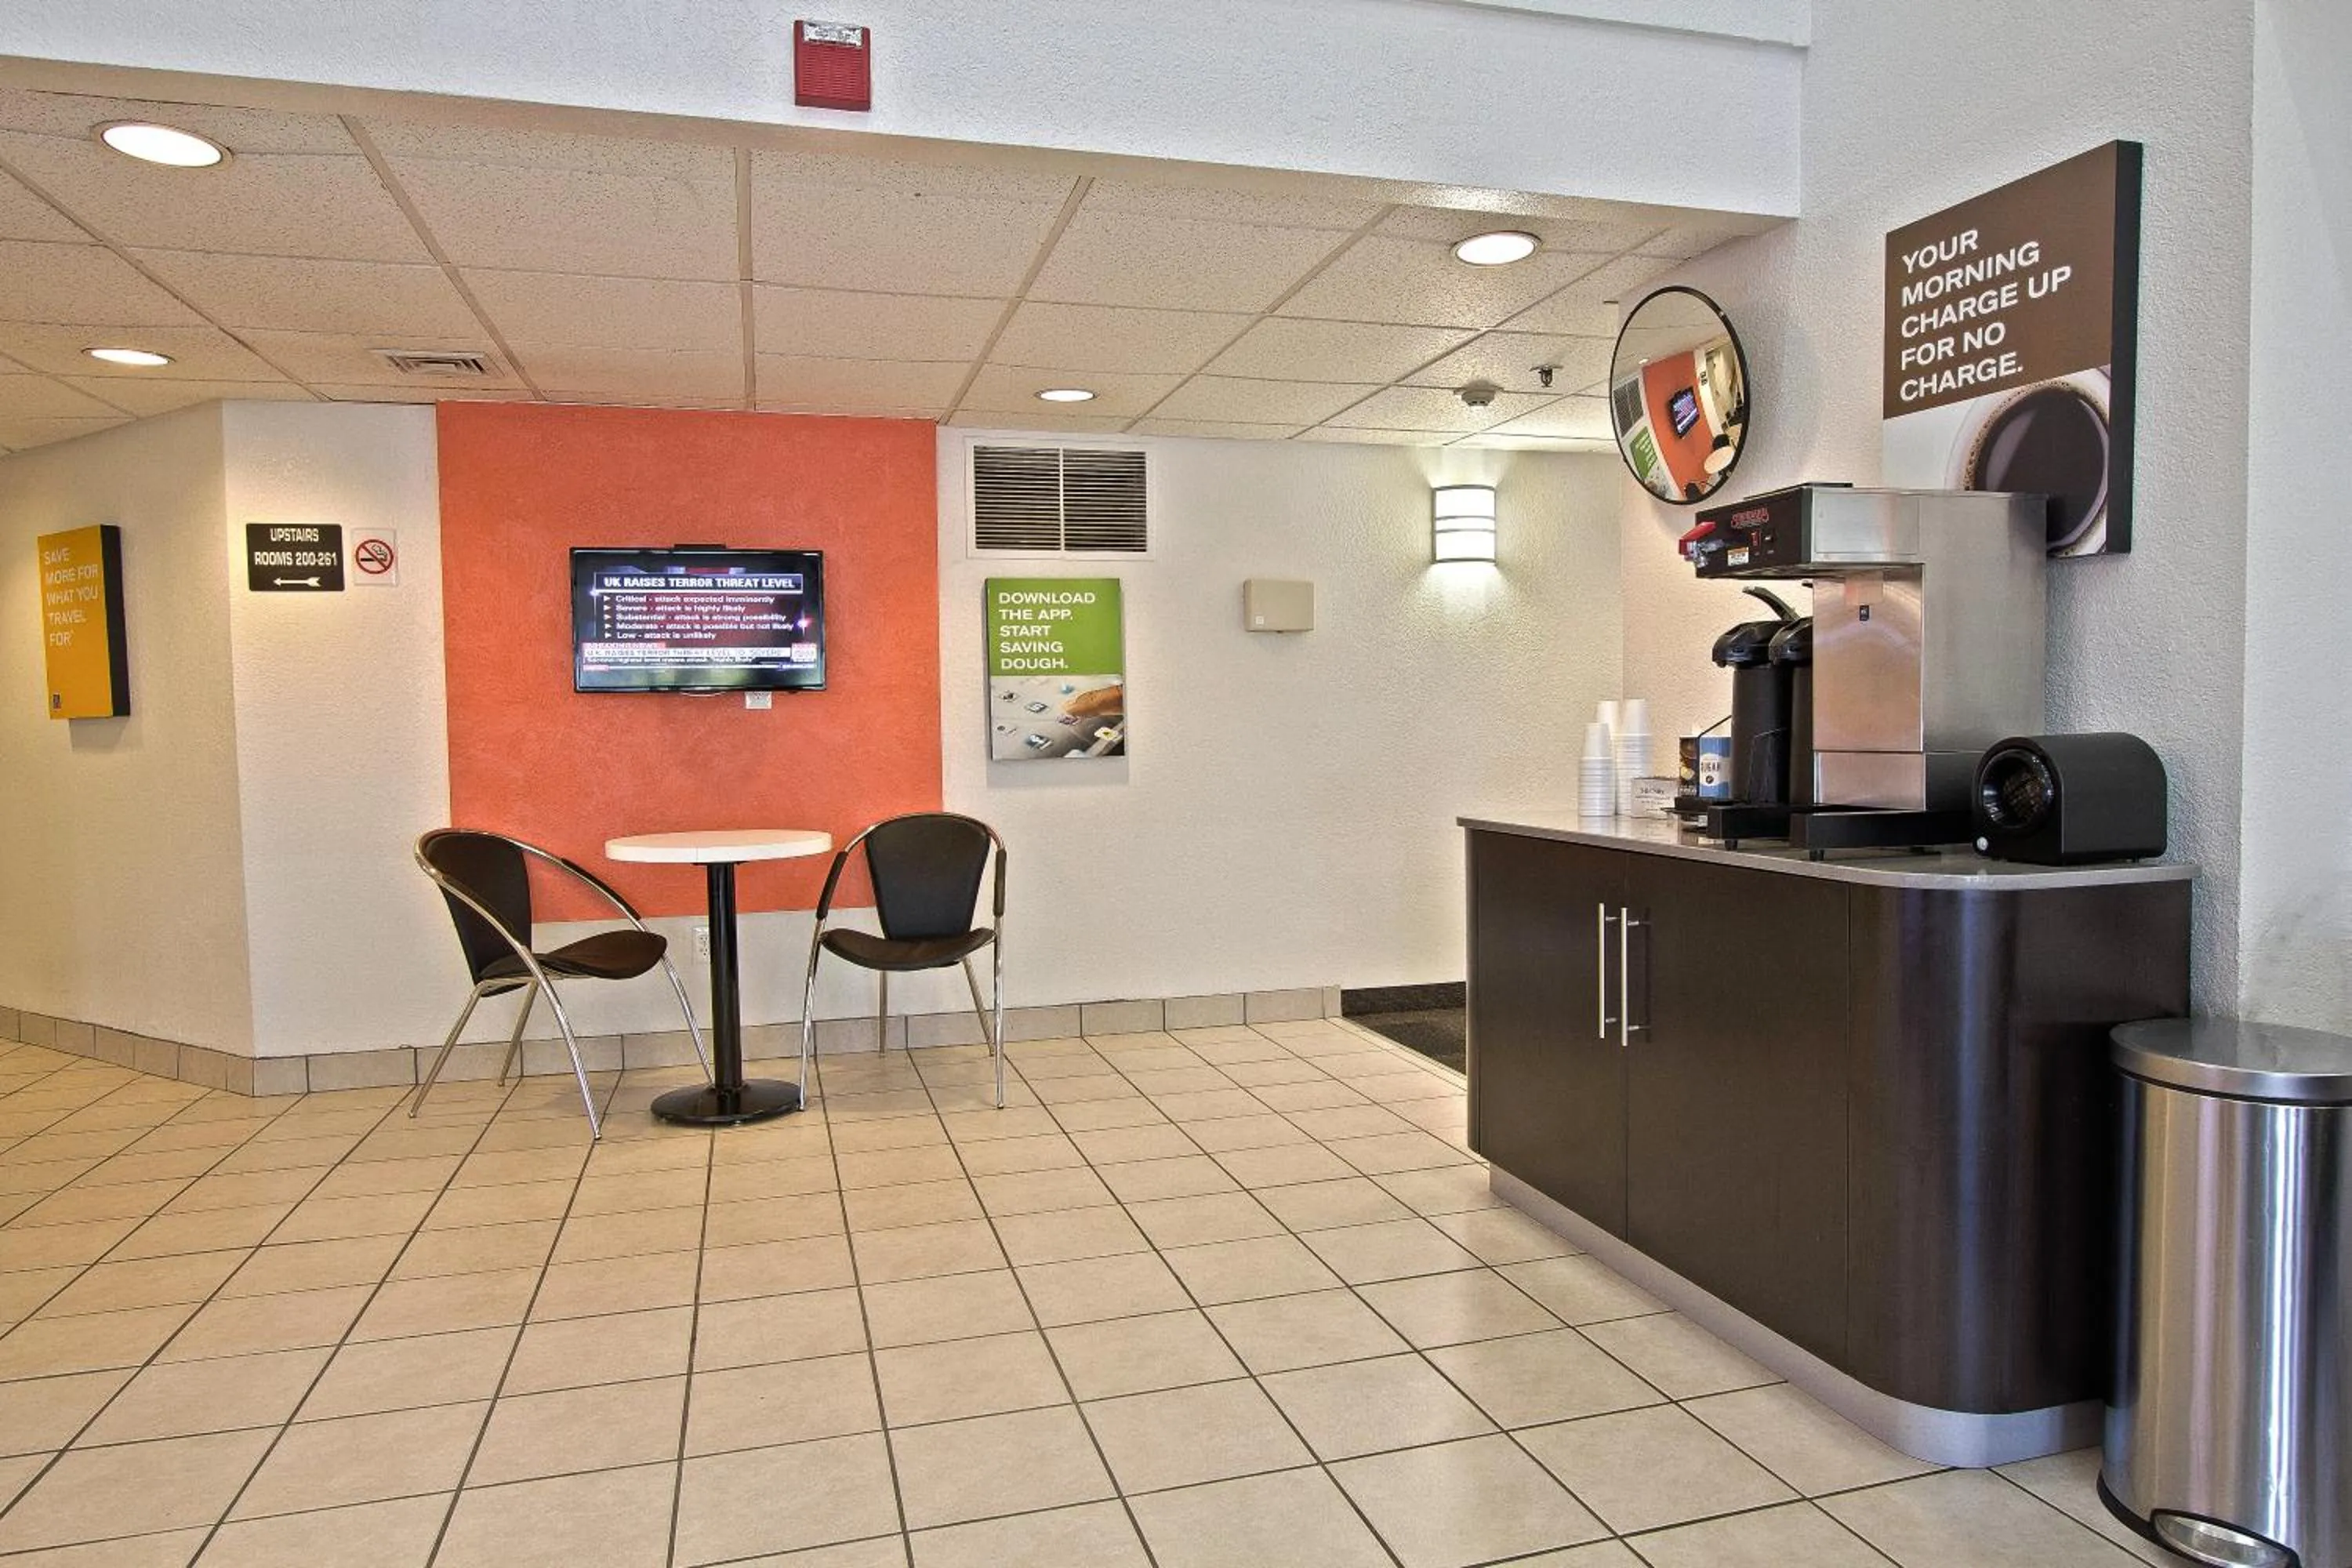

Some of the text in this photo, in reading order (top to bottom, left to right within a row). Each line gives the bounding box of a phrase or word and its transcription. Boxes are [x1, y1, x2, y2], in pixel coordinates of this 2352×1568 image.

[1902, 229, 1979, 274] YOUR
[1901, 241, 2040, 308] MORNING
[1901, 265, 2071, 339] CHARGE UP
[1900, 321, 2006, 371] FOR NO
[1900, 351, 2024, 402] CHARGE.
[270, 528, 319, 542] UPSTAIRS
[44, 548, 70, 565] SAVE
[254, 551, 337, 566] ROOMS 200-261
[45, 564, 98, 585] MORE FOR
[604, 577, 795, 589] UK RAISES TERROR THREAT LEVEL
[46, 587, 98, 606] WHAT YOU
[683, 596, 724, 604] expected
[998, 592, 1096, 604] DOWNLOAD
[48, 610, 86, 625] TRAVEL
[999, 609, 1073, 620] THE APP.
[616, 631, 637, 640] Low
[683, 631, 716, 641] unlikely
[1000, 625, 1051, 637] START
[1000, 641, 1063, 653] SAVING
[1001, 658, 1069, 670] DOUGH.
